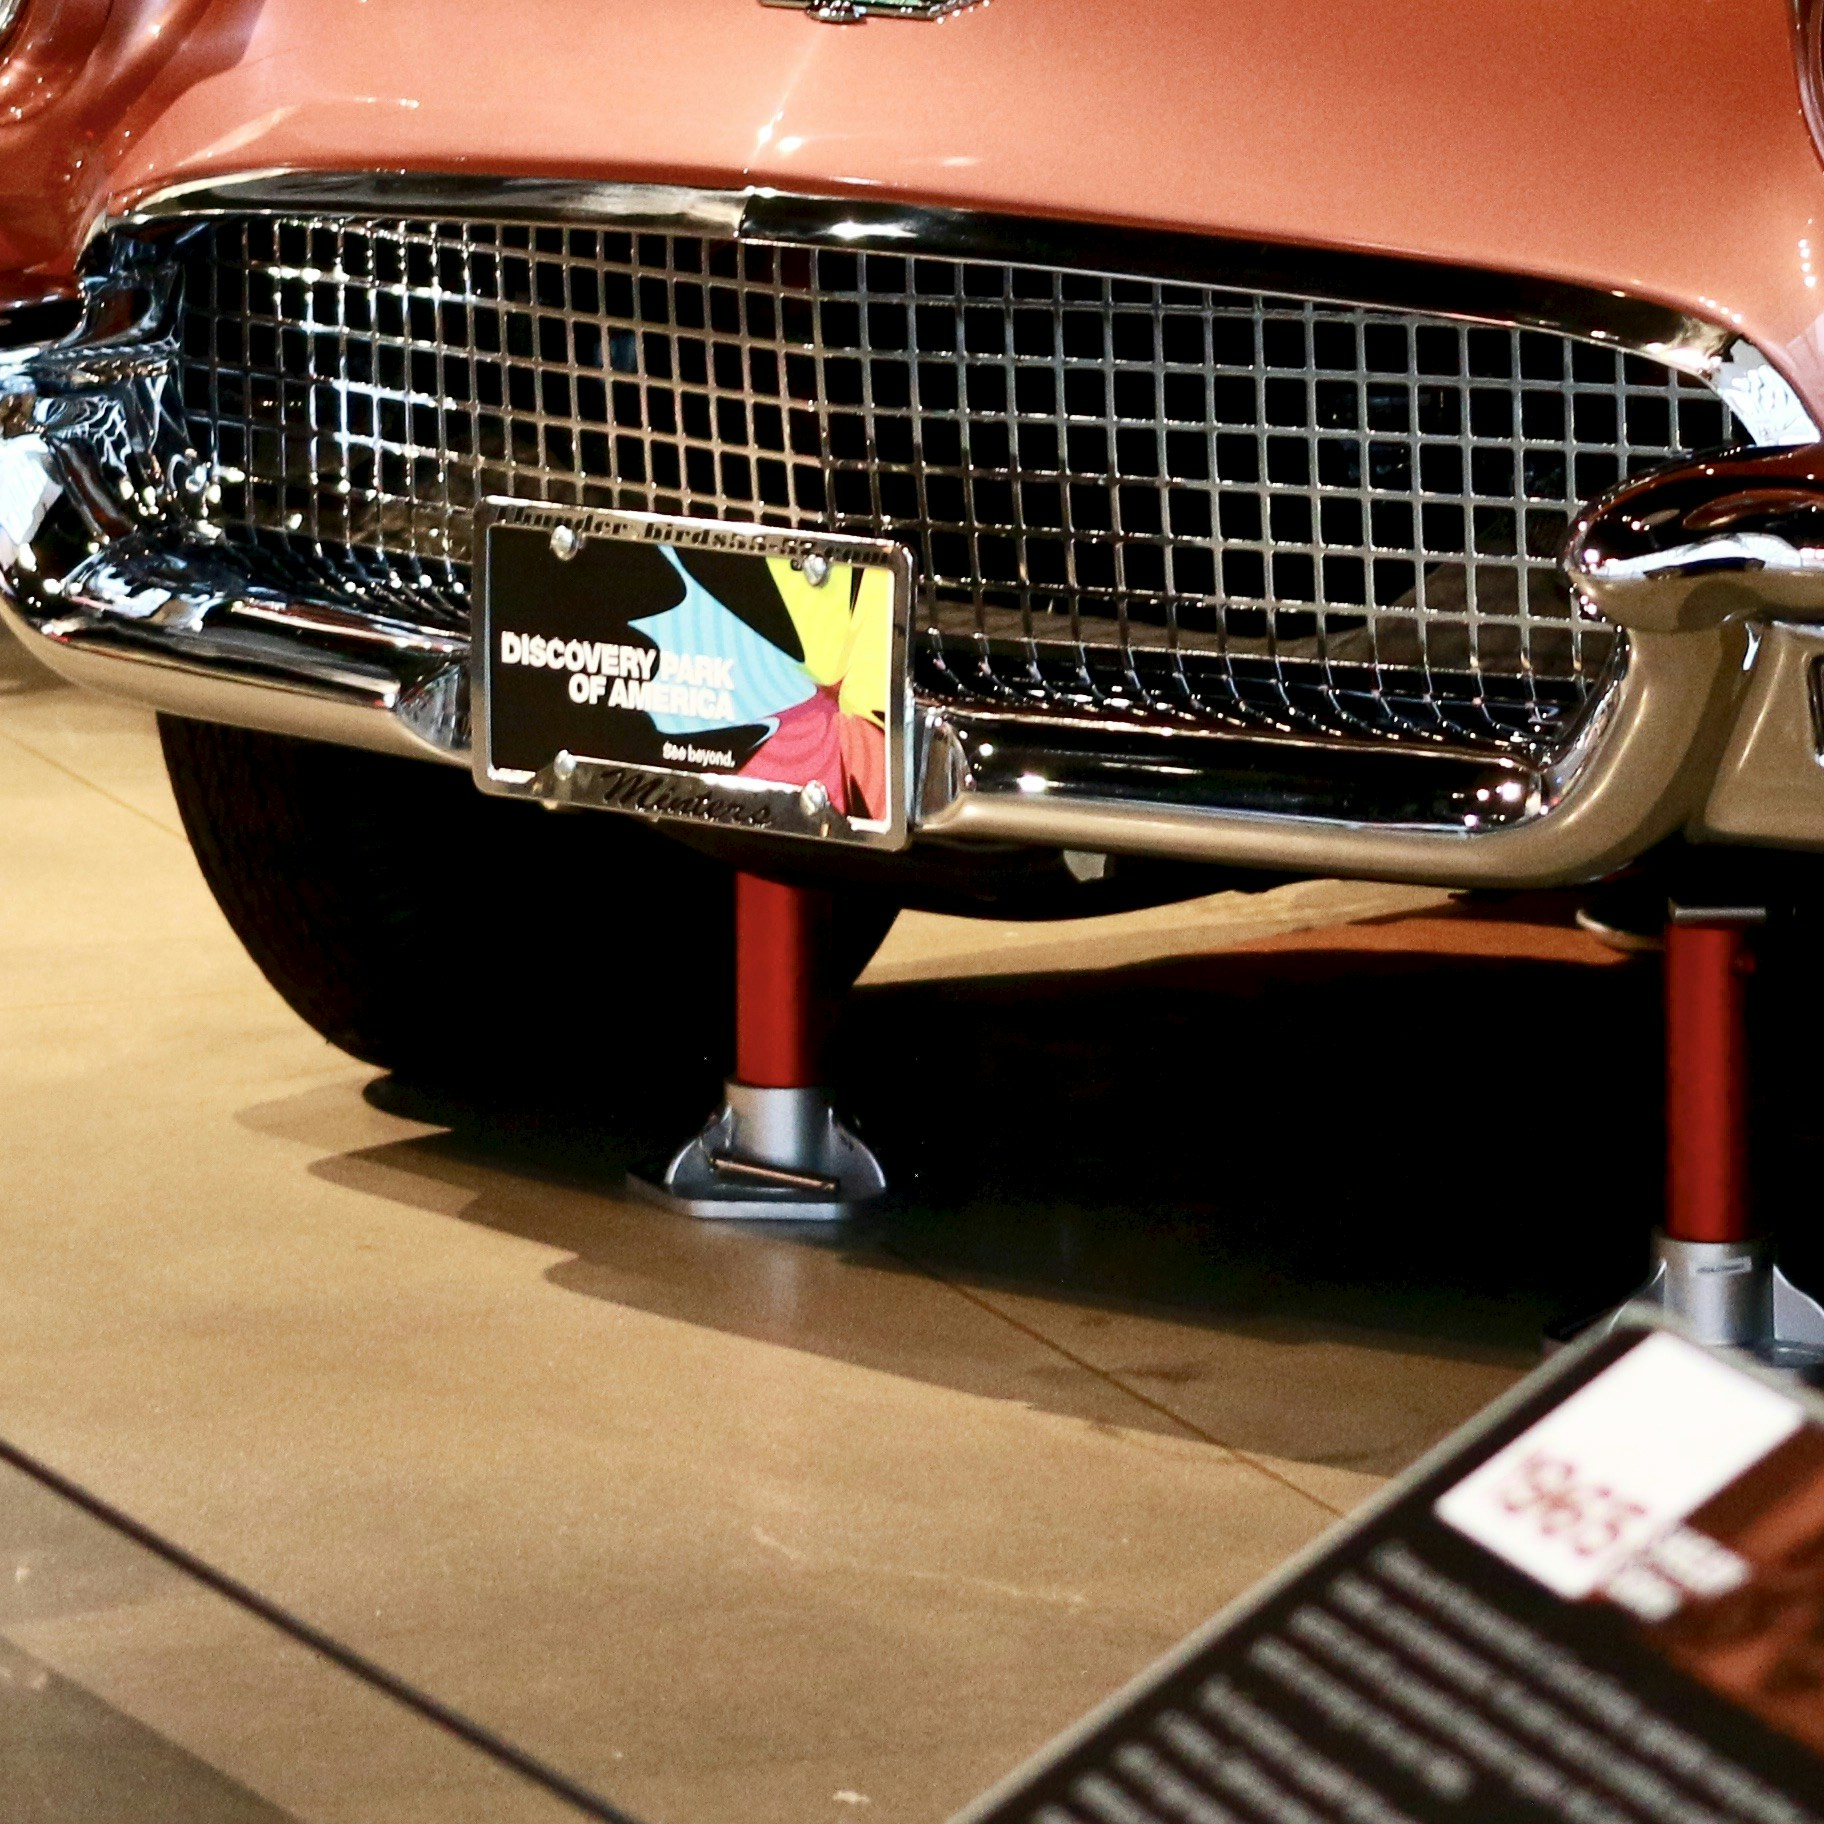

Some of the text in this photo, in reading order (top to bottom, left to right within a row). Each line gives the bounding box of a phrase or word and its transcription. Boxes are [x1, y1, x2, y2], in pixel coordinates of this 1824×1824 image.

[501, 630, 735, 690] DISCOVERY PARK
[568, 672, 736, 722] OF AMERICA
[687, 742, 736, 768] beyond.
